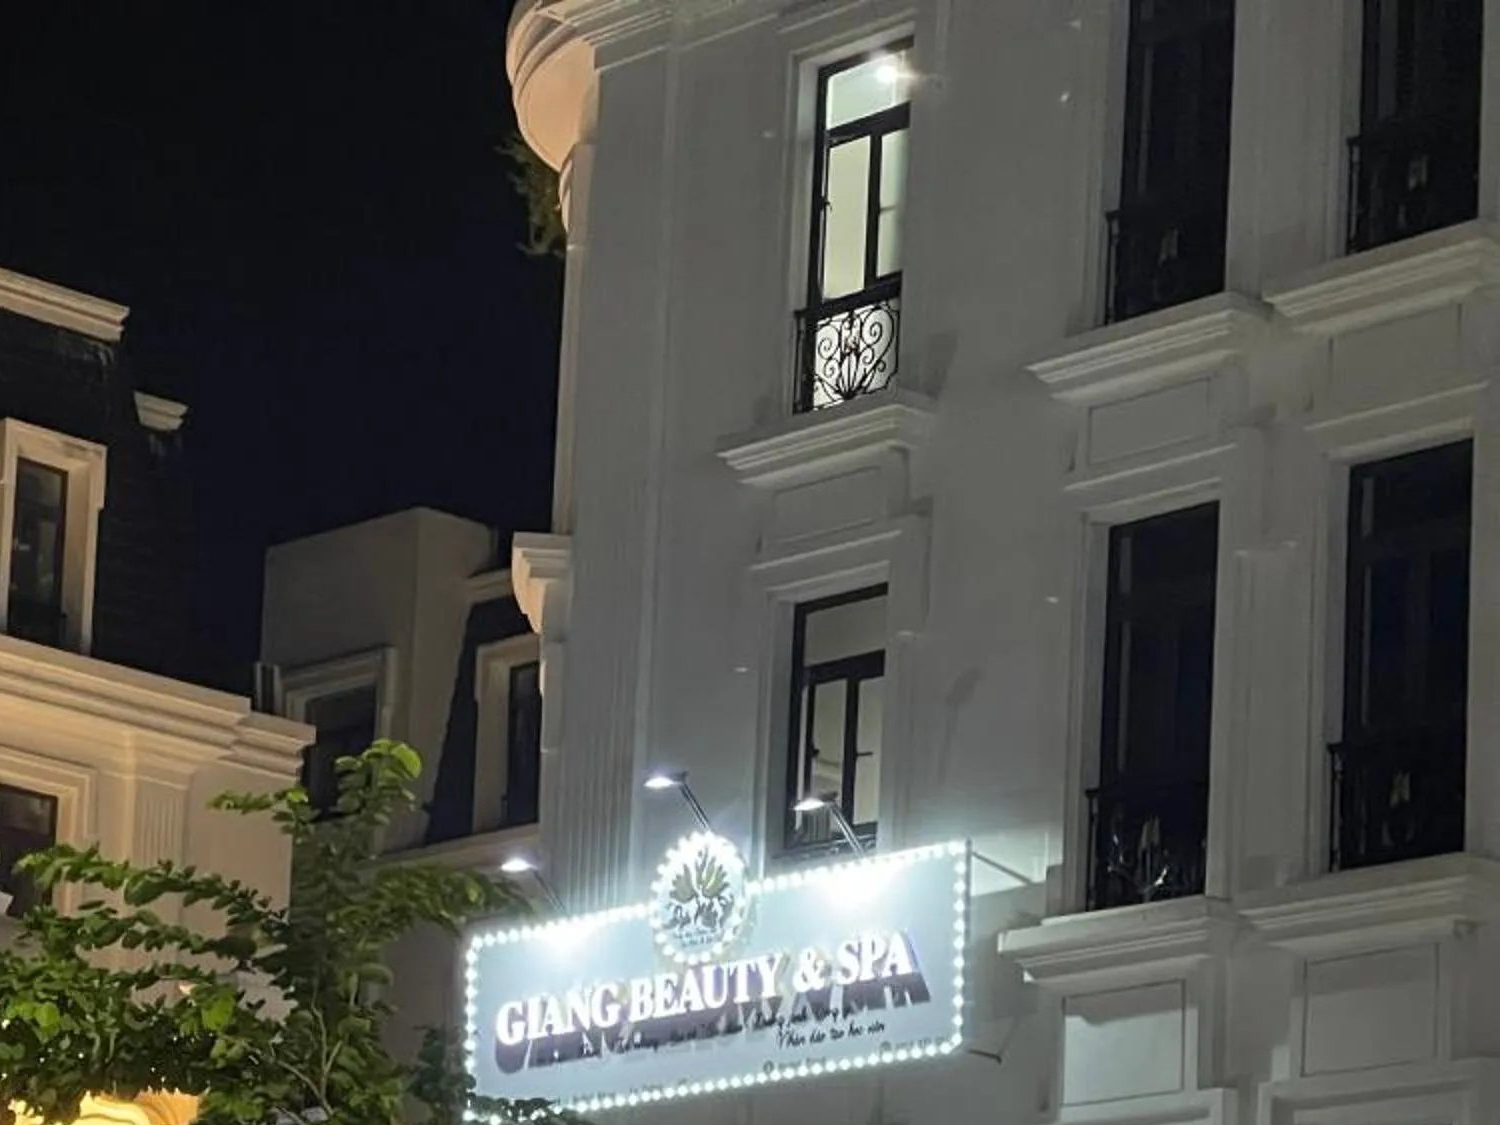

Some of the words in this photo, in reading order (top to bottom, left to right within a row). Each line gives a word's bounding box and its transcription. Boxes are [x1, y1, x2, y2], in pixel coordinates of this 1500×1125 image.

[496, 978, 621, 1046] GIANG
[627, 953, 784, 1021] BEAUTY
[793, 947, 826, 993] &
[836, 930, 916, 984] SPA
